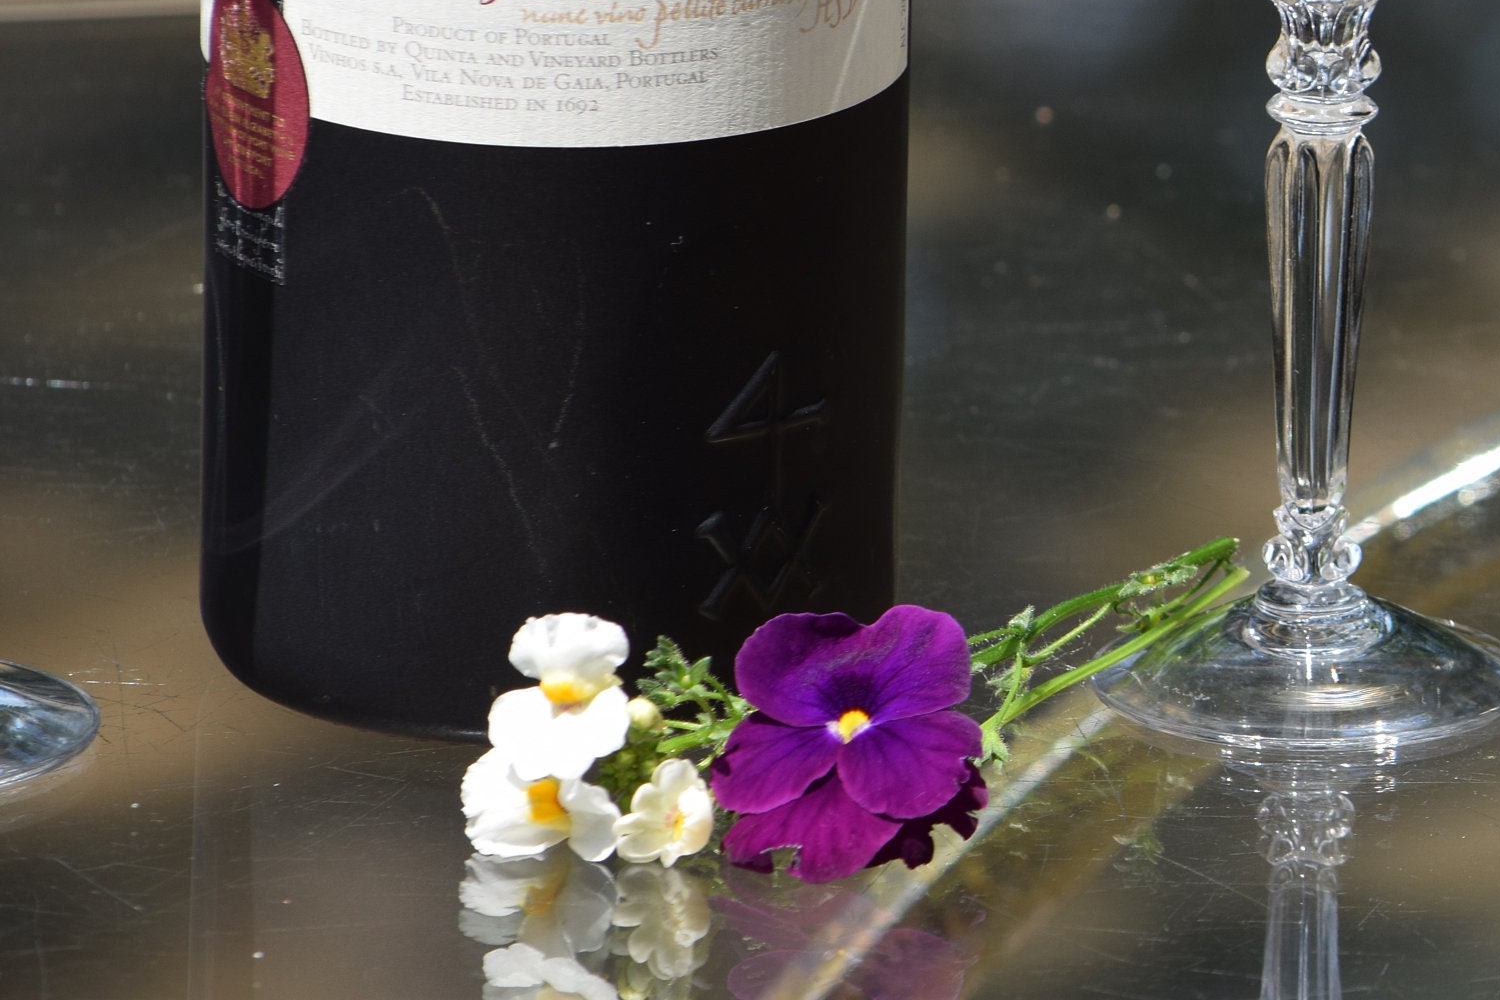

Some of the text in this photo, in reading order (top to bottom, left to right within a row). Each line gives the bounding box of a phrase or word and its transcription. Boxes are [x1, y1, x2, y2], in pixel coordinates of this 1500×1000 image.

[301, 18, 719, 68] BOTTLED BY QUINTA AND VINEYARD BOTTLERS
[392, 16, 612, 47] PRODUCT OF PORTUGAL
[309, 42, 367, 72] VINHOS
[410, 63, 451, 84] VILA
[459, 68, 514, 89] NOVA
[522, 76, 547, 90] DE
[615, 70, 709, 89] PORTUGAL
[402, 84, 599, 116] ESTABLISHED IN 1692
